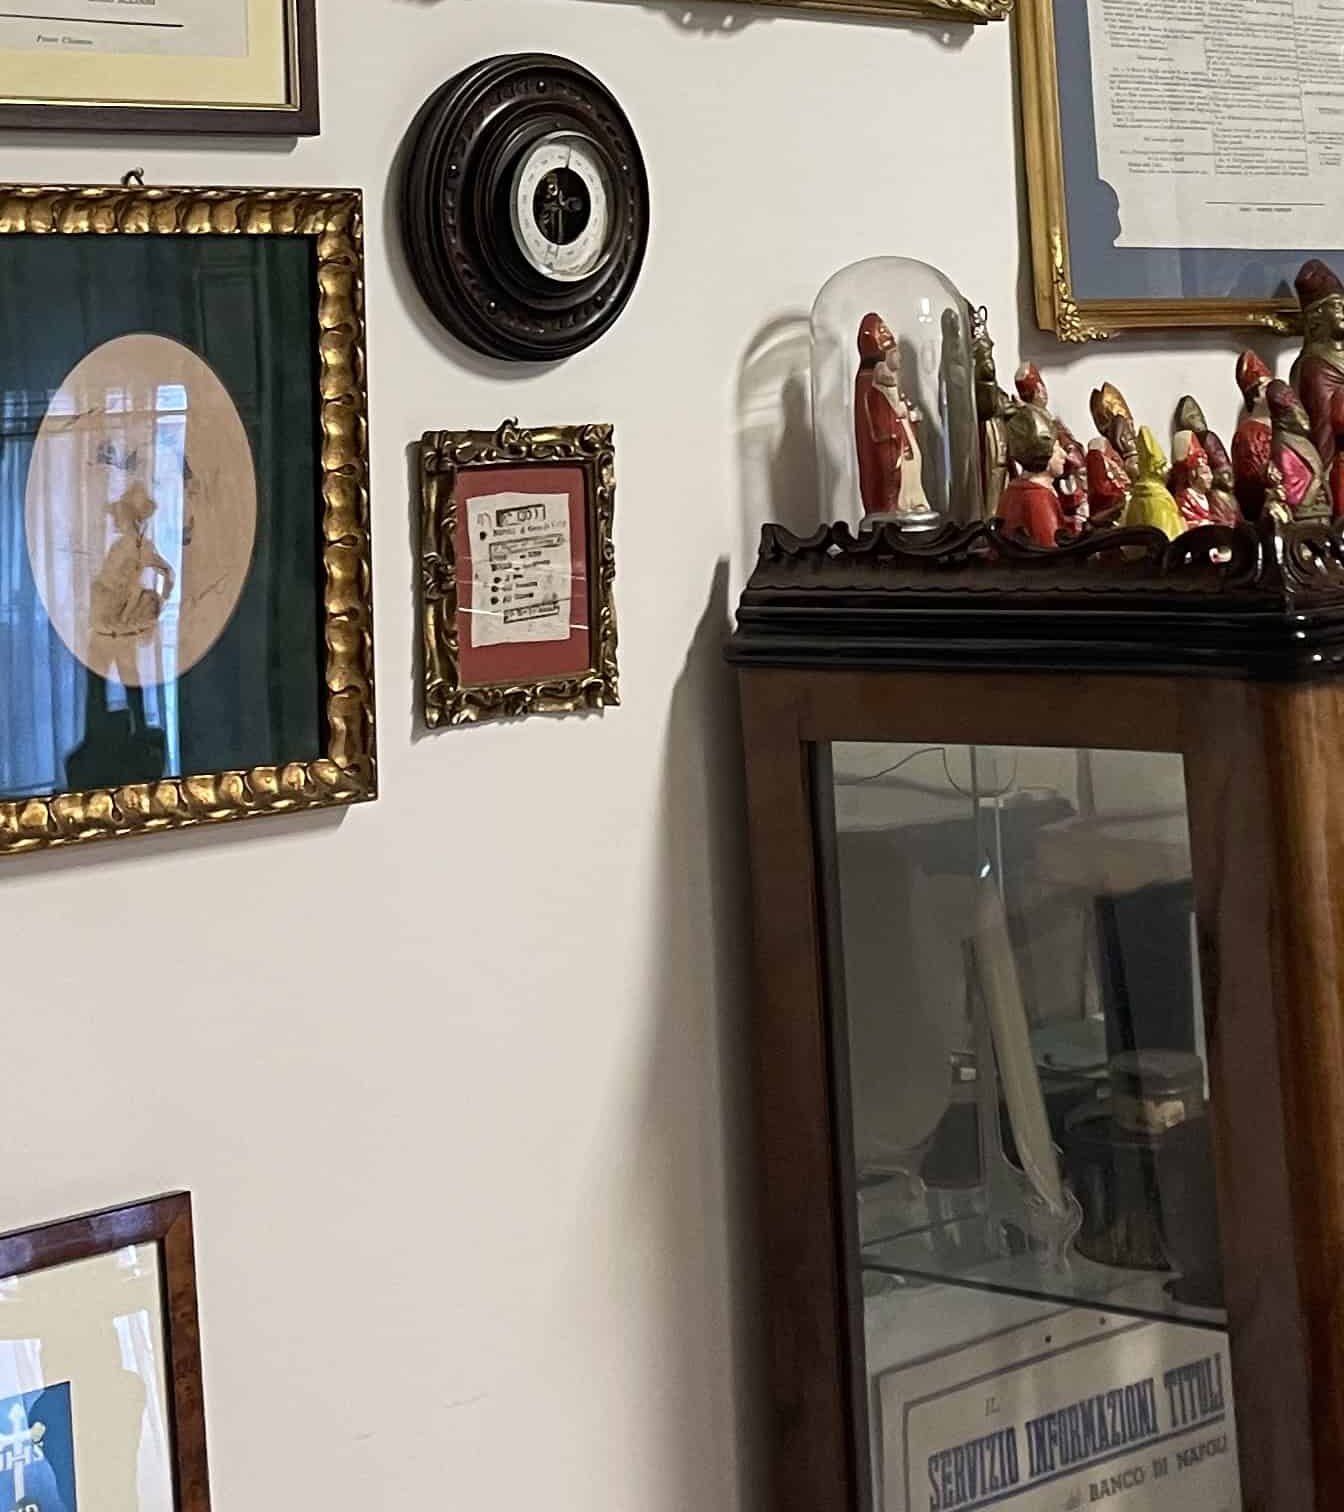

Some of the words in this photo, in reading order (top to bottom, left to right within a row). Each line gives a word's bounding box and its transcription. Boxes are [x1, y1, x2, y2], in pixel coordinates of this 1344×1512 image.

[927, 1426, 1019, 1512] SERVIZIO
[1025, 1377, 1160, 1479] INFORMAZIONI
[1164, 1352, 1225, 1429] TITOLI
[1089, 1467, 1147, 1503] BANCO
[1151, 1457, 1169, 1479] DI
[1177, 1434, 1228, 1471] NAPOLI
